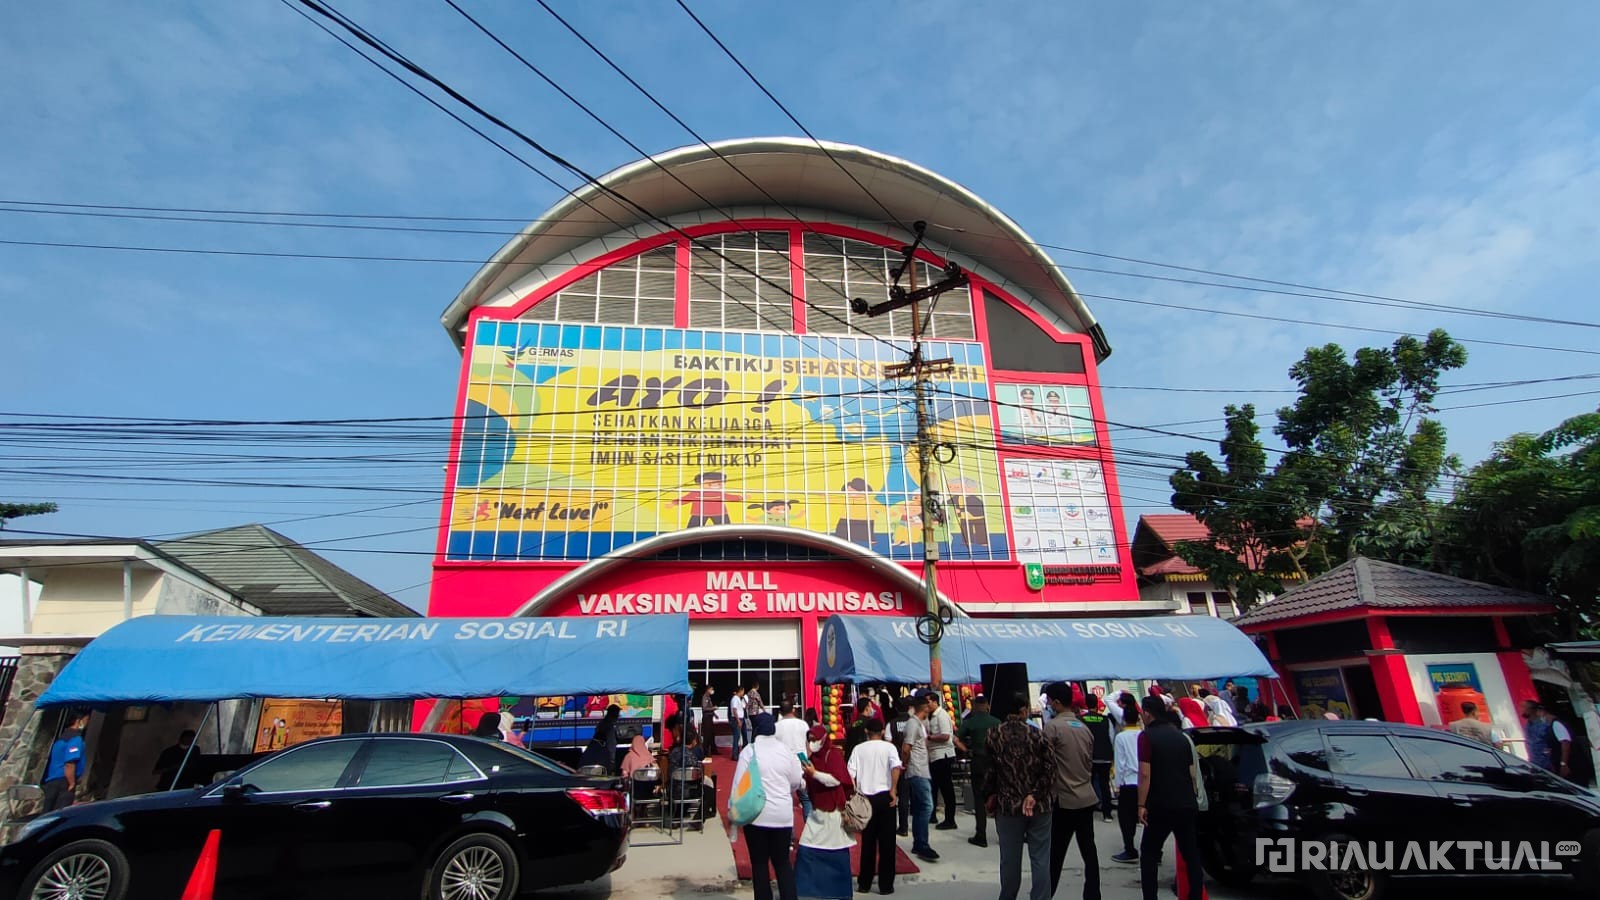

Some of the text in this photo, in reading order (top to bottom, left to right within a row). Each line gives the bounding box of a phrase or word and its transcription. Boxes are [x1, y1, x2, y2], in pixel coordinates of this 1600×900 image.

[528, 347, 575, 358] GERMAS
[674, 354, 773, 373] BAKTIKU
[592, 413, 773, 431] SEHATKAN KELUARGA
[683, 452, 763, 468] LENGKAP
[705, 570, 778, 592] MALL
[577, 591, 904, 614] VAKSINASI & IMUNISASI
[175, 619, 628, 643] KEMENTERIAN SOSIAL RI
[1071, 621, 1166, 639] SOSIAL
[1163, 622, 1199, 638] RI
